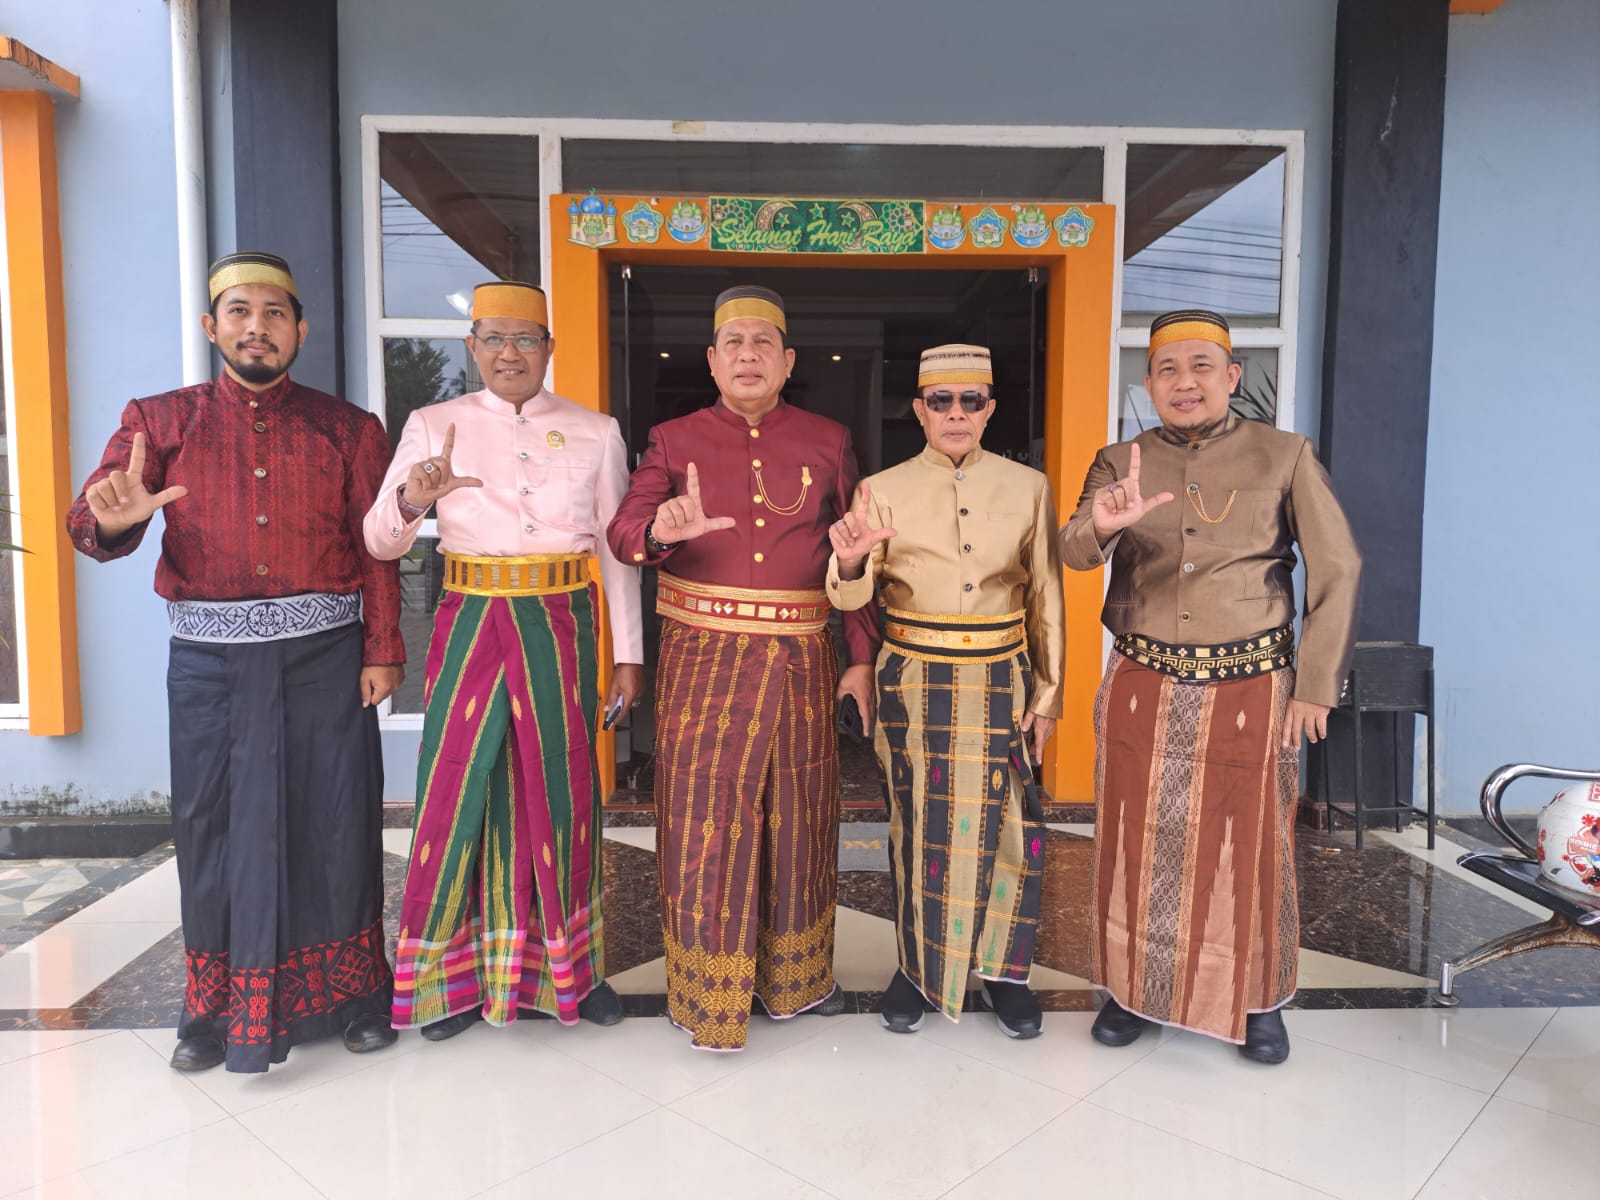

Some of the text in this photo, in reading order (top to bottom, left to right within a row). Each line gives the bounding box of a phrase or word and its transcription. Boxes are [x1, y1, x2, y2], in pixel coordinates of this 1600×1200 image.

[718, 218, 917, 254] Selamat Hari Raya
